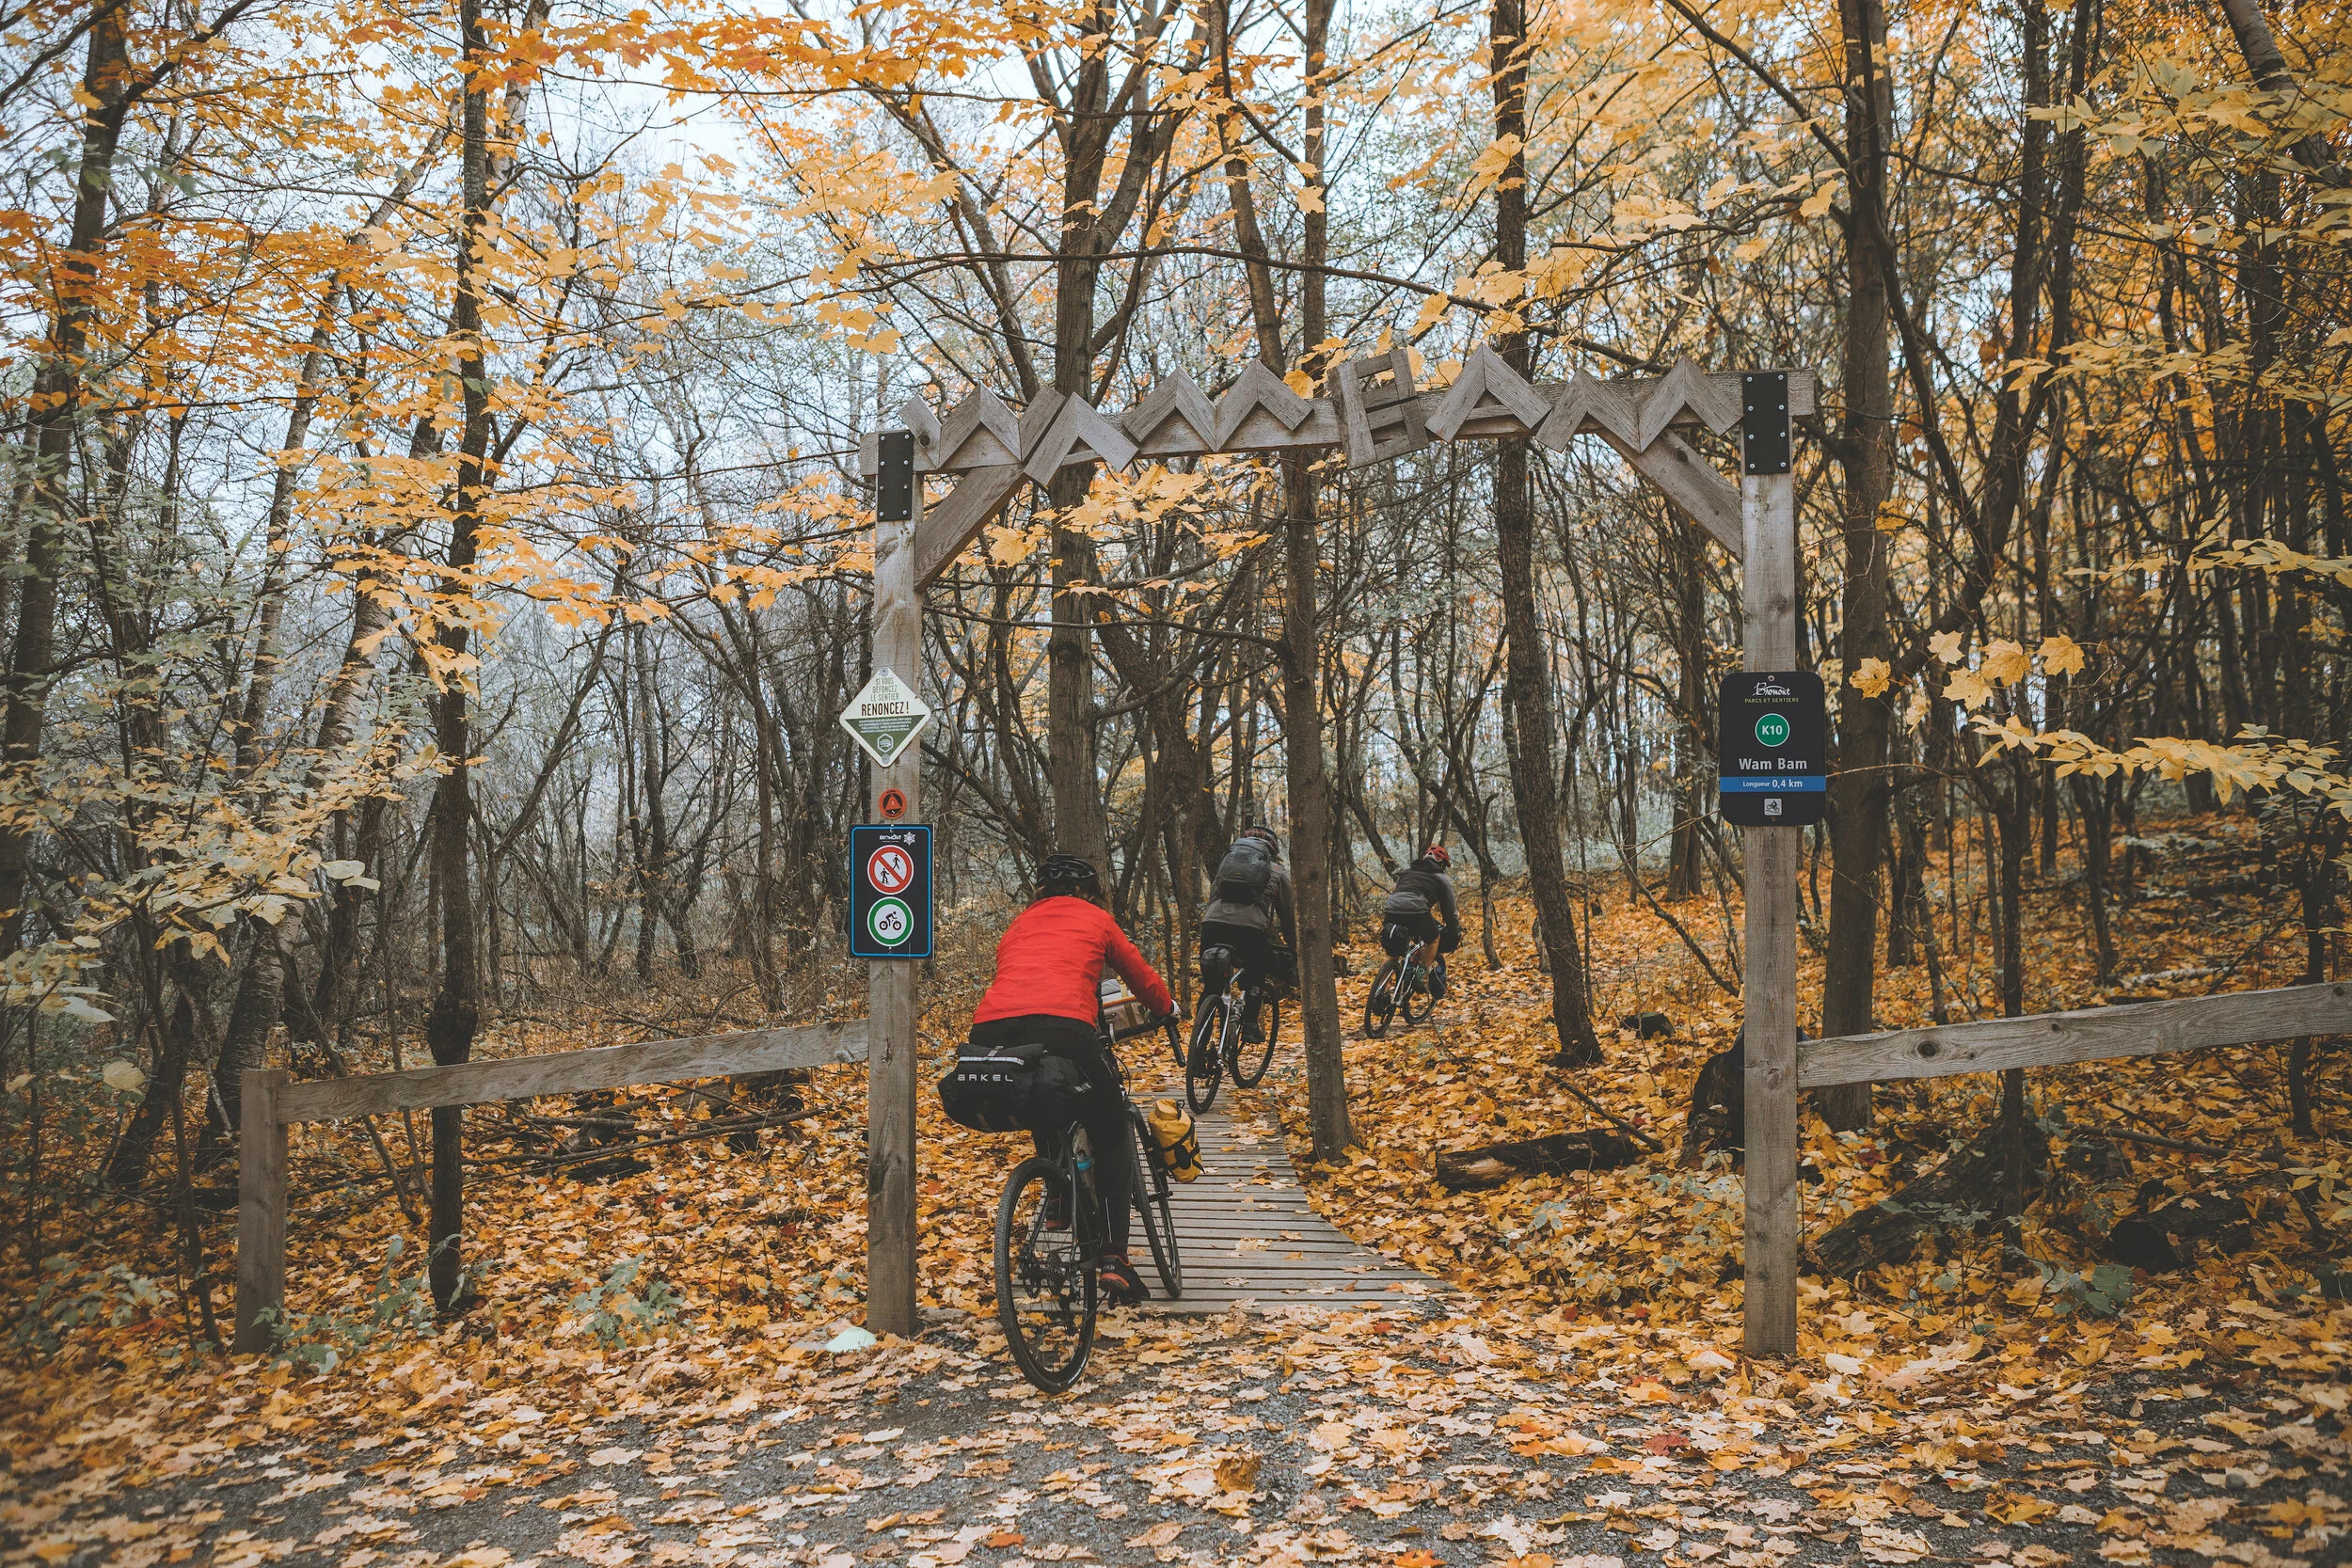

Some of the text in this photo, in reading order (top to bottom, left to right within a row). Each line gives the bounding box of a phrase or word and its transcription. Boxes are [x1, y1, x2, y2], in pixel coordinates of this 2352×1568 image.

[875, 677, 881, 686] SI
[879, 692, 899, 701] SENTIER
[1762, 725, 1783, 736] K10
[1739, 757, 1807, 770] Wam Bam
[1772, 779, 1787, 788] 0,4
[1788, 779, 1803, 787] km
